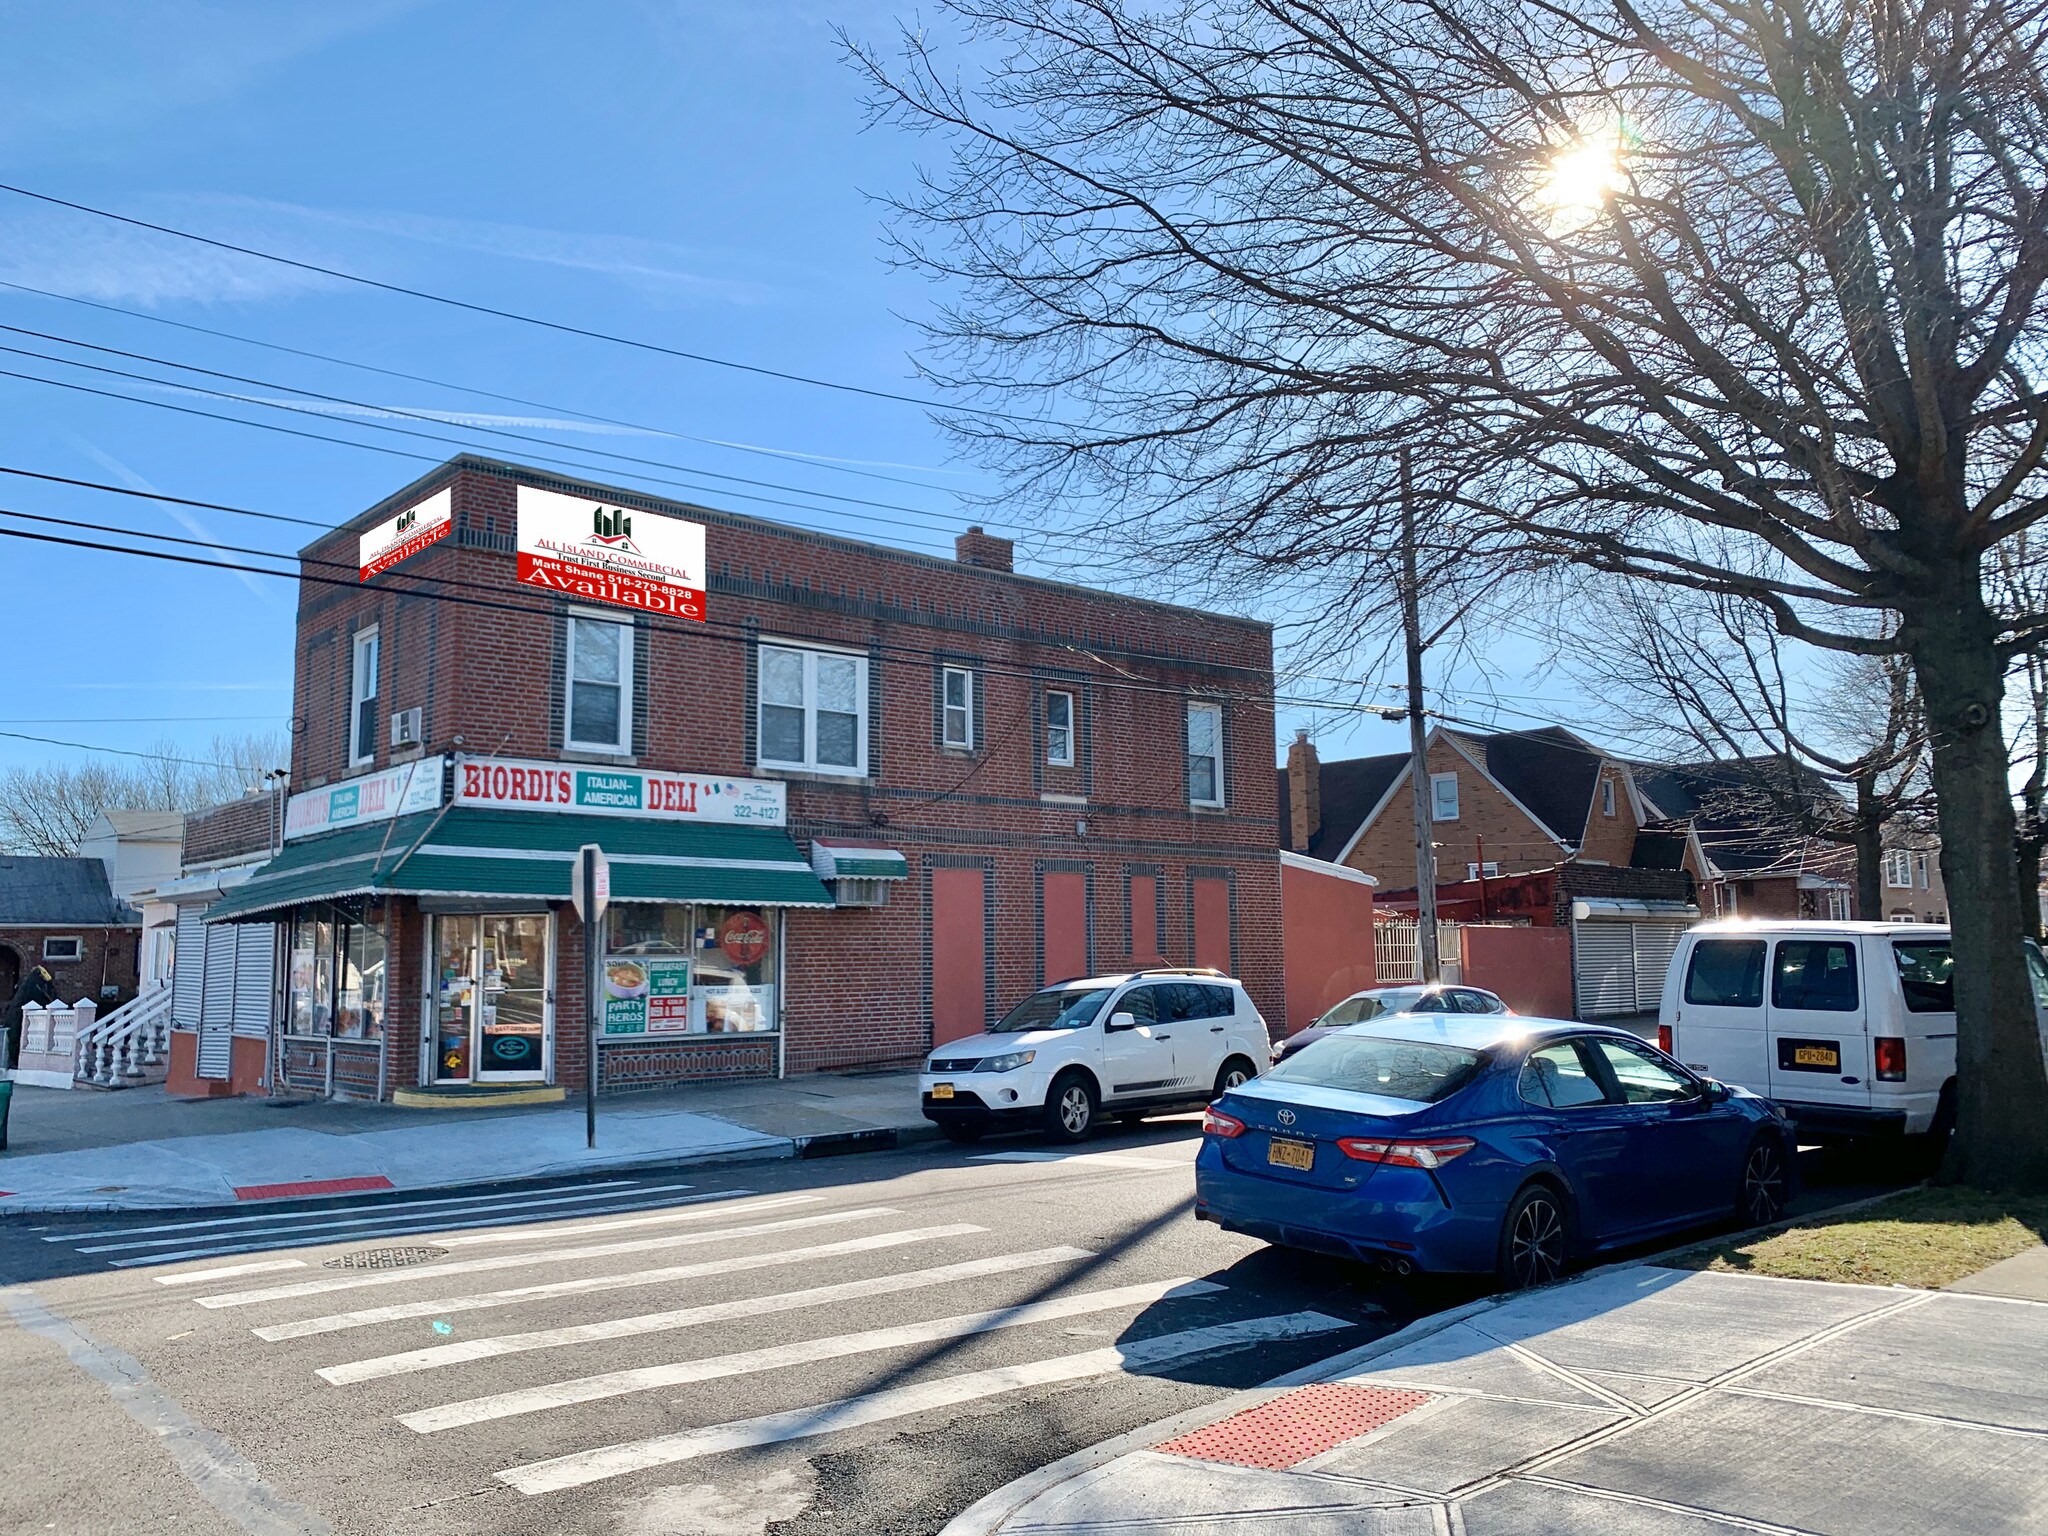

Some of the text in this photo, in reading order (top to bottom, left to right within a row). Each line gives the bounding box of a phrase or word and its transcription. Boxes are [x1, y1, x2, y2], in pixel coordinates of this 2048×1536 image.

[364, 529, 448, 580] Available
[537, 538, 689, 579] ALL ISLAND COMMERCIAL
[556, 552, 666, 582] Trust First Business Second
[525, 568, 699, 617] Available
[532, 558, 692, 599] Matt Shane 516-279-8828
[360, 779, 387, 814] DELI
[463, 764, 571, 804] BIORDI'S
[584, 792, 638, 806] AMERICAN
[647, 778, 698, 813] DELI
[734, 805, 780, 819] 322-4127
[651, 963, 687, 971] BREAKFAST
[608, 1000, 644, 1013] PARTY
[1259, 1124, 1320, 1138] CAMRY
